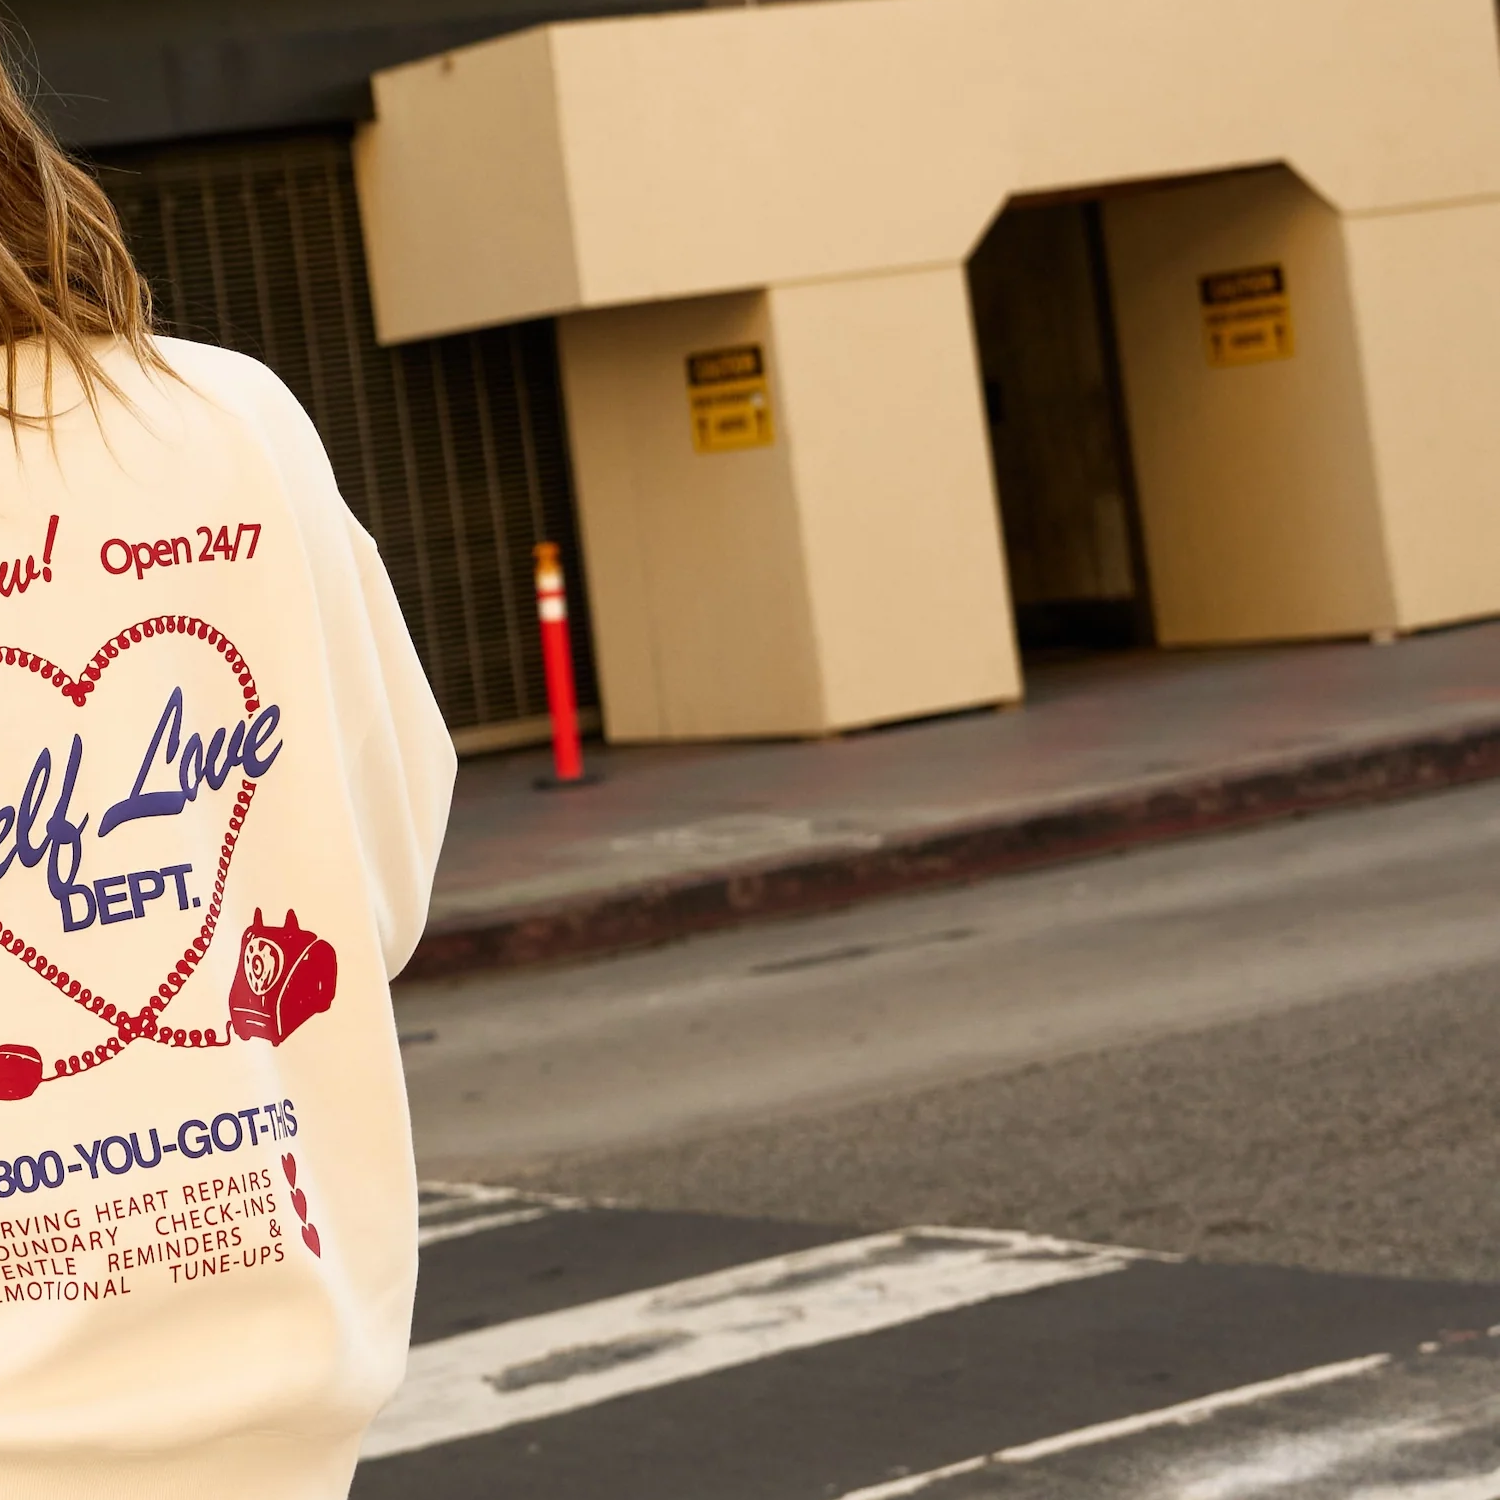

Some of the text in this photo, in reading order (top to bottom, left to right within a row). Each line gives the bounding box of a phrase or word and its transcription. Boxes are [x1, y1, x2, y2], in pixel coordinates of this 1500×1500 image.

[99, 523, 262, 580] Open 24/7
[98, 686, 283, 837] Love
[61, 863, 201, 932] DEPT.
[95, 1190, 168, 1223] HEART
[183, 1168, 272, 1205] REPAIRS
[155, 1194, 277, 1236] CHECK-INS
[107, 1226, 243, 1272] REMINDERS
[269, 1219, 283, 1238] &
[169, 1243, 286, 1283] TUNE-UPS
